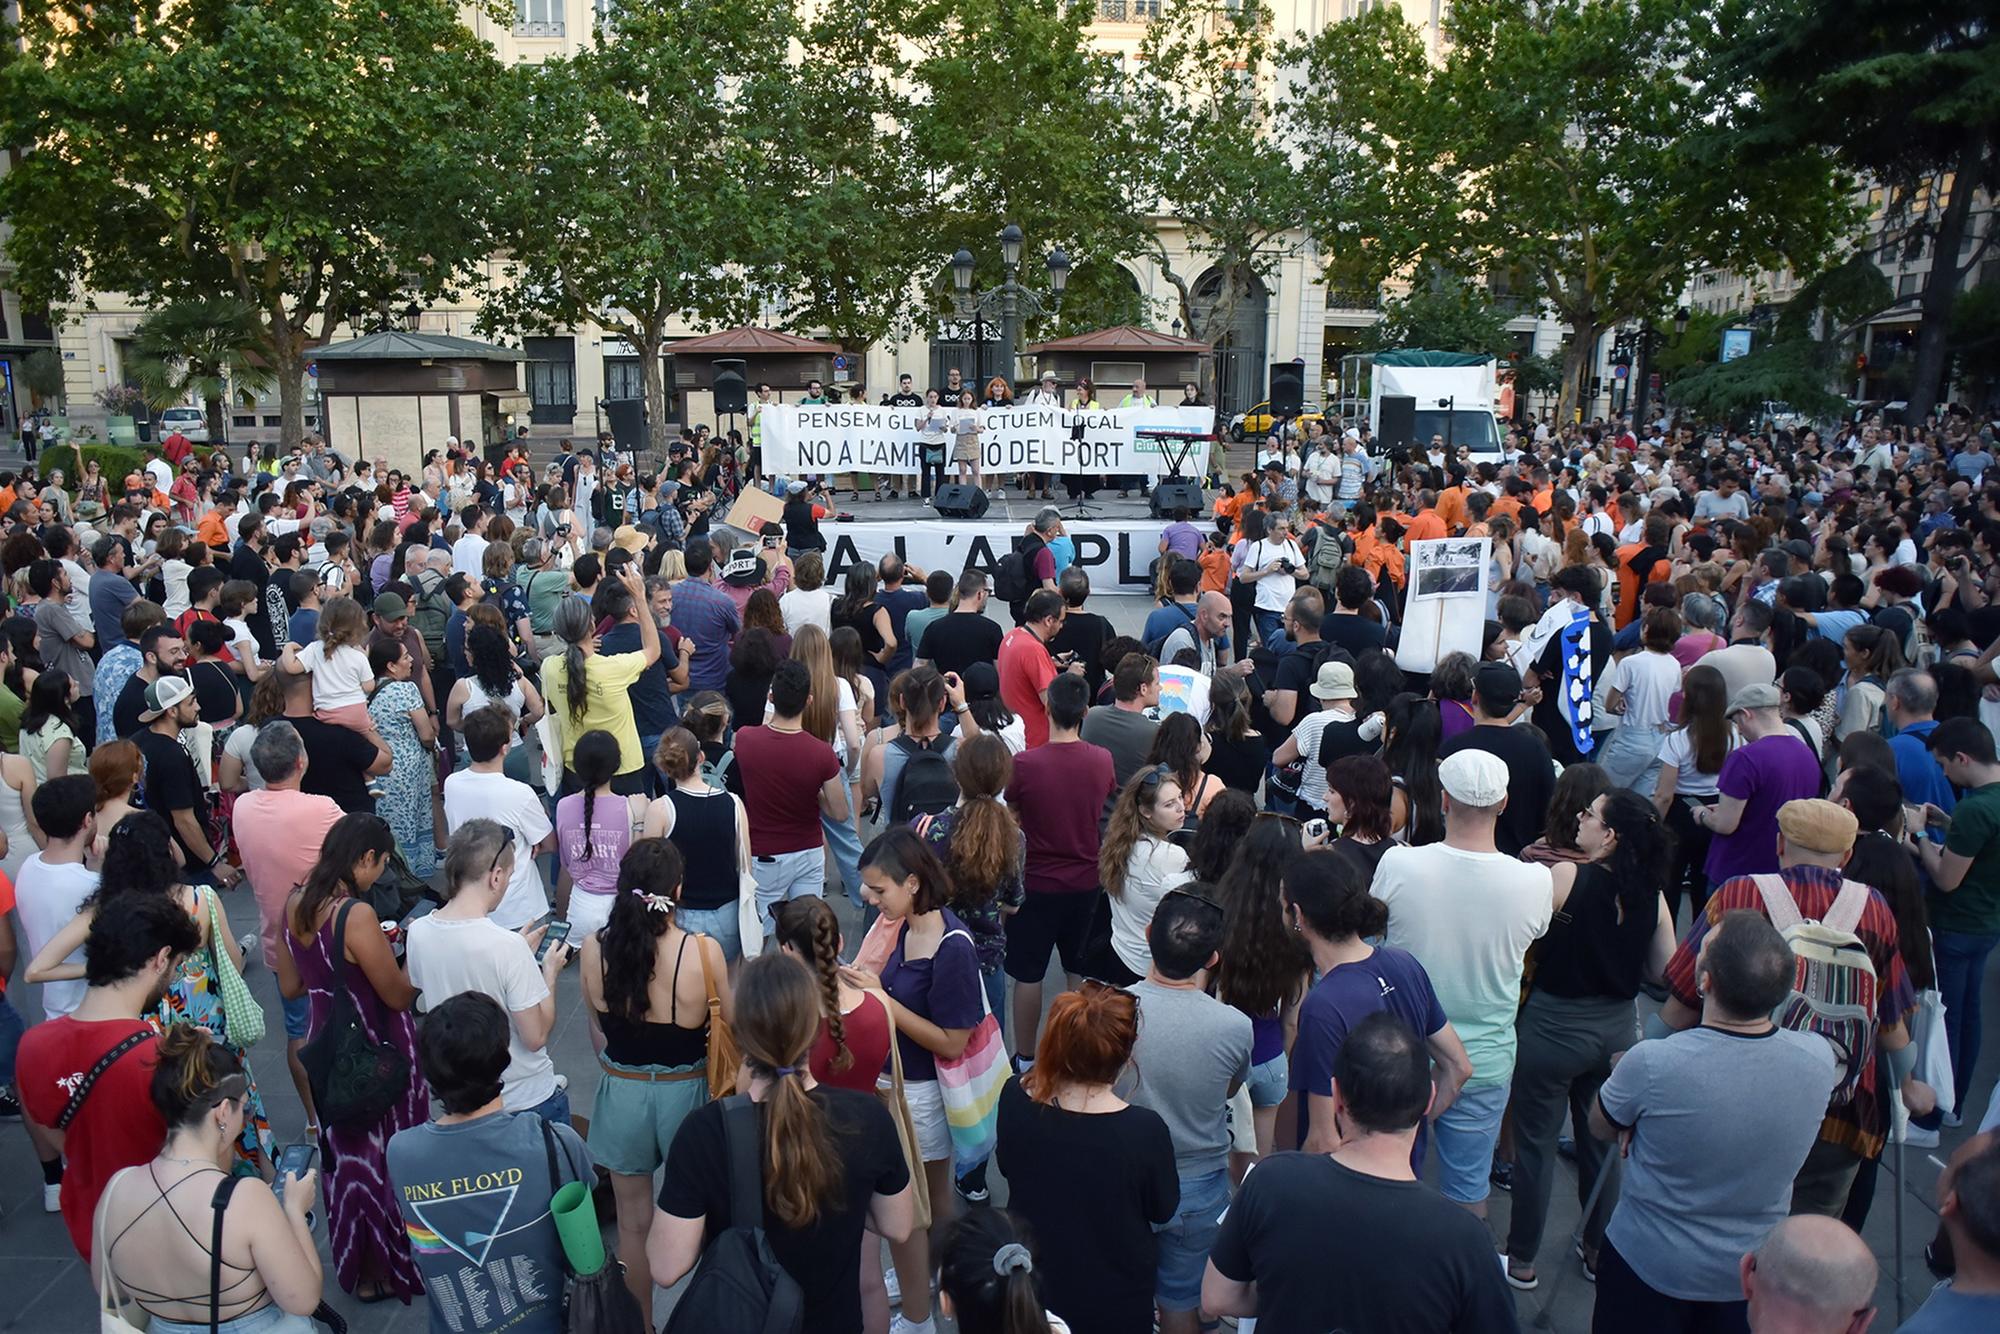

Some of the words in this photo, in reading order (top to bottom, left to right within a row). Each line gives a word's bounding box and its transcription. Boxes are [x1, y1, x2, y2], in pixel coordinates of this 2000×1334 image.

[798, 411, 881, 428] PENSEM
[985, 412, 1054, 430] CTUEM
[1061, 413, 1124, 430] LOCAL
[798, 440, 831, 466] NO
[838, 440, 853, 466] A
[1010, 439, 1054, 466] DEL
[1062, 441, 1124, 467] PORT
[404, 1181, 446, 1201] PINK
[451, 1167, 523, 1195] FLOYD
